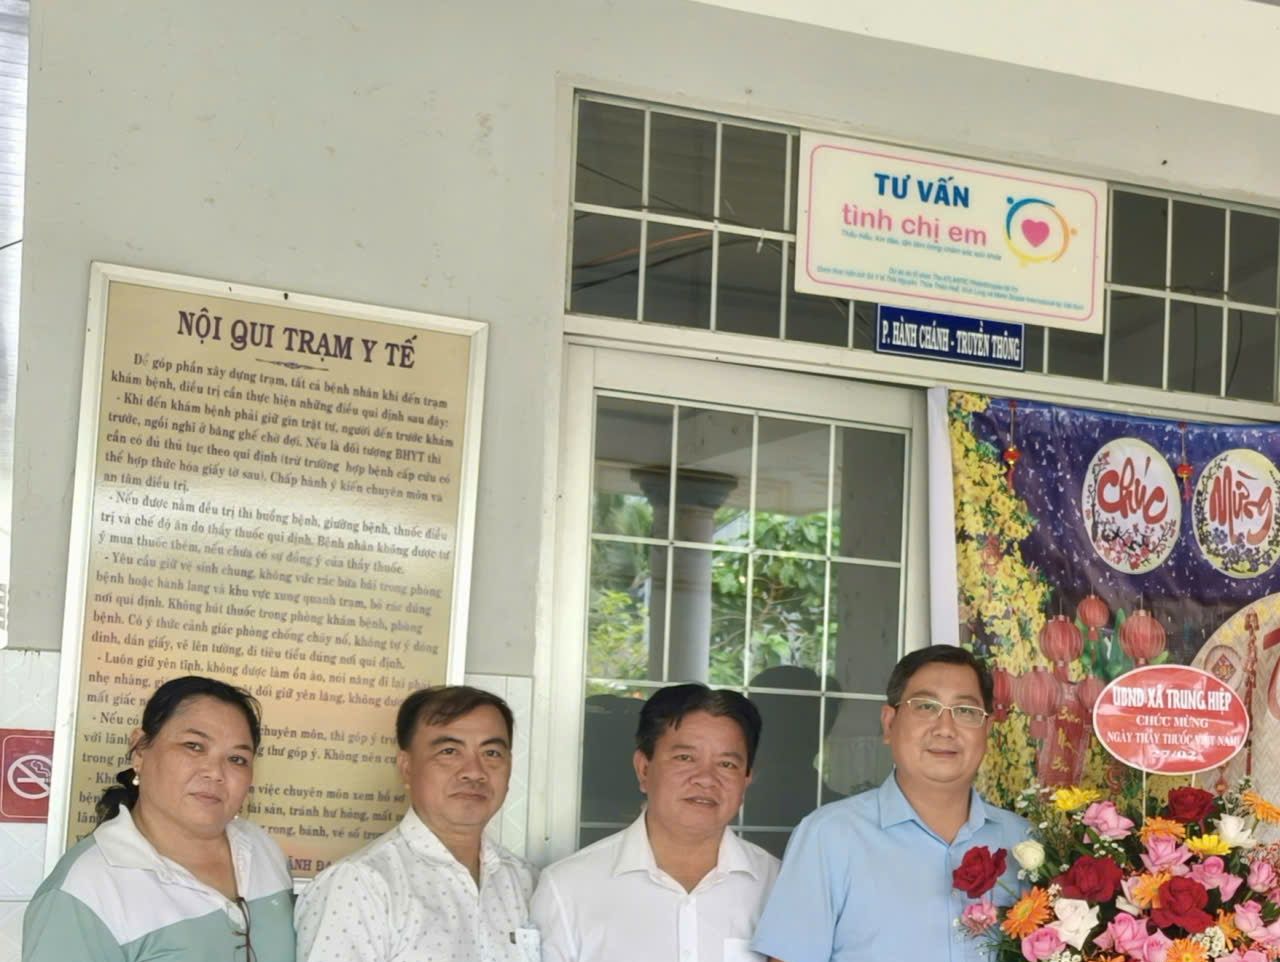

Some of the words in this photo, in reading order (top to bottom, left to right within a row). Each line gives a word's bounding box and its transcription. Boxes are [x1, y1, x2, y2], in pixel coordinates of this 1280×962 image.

[874, 173, 910, 199] TƯ
[917, 177, 969, 207] VẤN
[842, 203, 892, 231] tình
[901, 211, 940, 243] chị
[950, 226, 987, 246] em
[177, 308, 222, 344] NỘI
[231, 320, 274, 351] QUI
[283, 328, 352, 362] TRẠM
[362, 339, 377, 363] Y
[385, 335, 418, 368] TẾ
[882, 320, 891, 343] P.
[892, 316, 917, 346] HÀNH
[919, 321, 949, 351] CHÁNH
[956, 321, 990, 357] TRUYỀN
[991, 331, 1020, 361] THÔNG
[111, 369, 142, 385] khám
[145, 375, 176, 391] bệnh,
[207, 385, 220, 398] trị
[246, 391, 269, 404] thực
[273, 394, 296, 407] hiện
[299, 397, 333, 414] những
[362, 408, 378, 420] qui
[407, 415, 424, 425] sau
[152, 355, 172, 371] góp
[207, 366, 225, 379] xây
[229, 368, 256, 383] dựng
[324, 381, 350, 395] bệnh
[353, 386, 379, 399] nhân
[382, 389, 398, 401] khi
[423, 397, 447, 409] trạm
[124, 392, 143, 406] Khi
[171, 399, 200, 414] khám
[204, 404, 231, 418] bệnh
[234, 409, 258, 422] phải
[395, 448, 425, 463] BHYT
[1112, 686, 1145, 707] UBND
[1166, 689, 1206, 711] TRUNG
[1207, 687, 1232, 715] HIỆP
[1107, 729, 1133, 743] NGÀY
[1163, 729, 1194, 745] THUỐC
[1136, 713, 1171, 728] CHÚC
[1173, 715, 1209, 729] MỪNG
